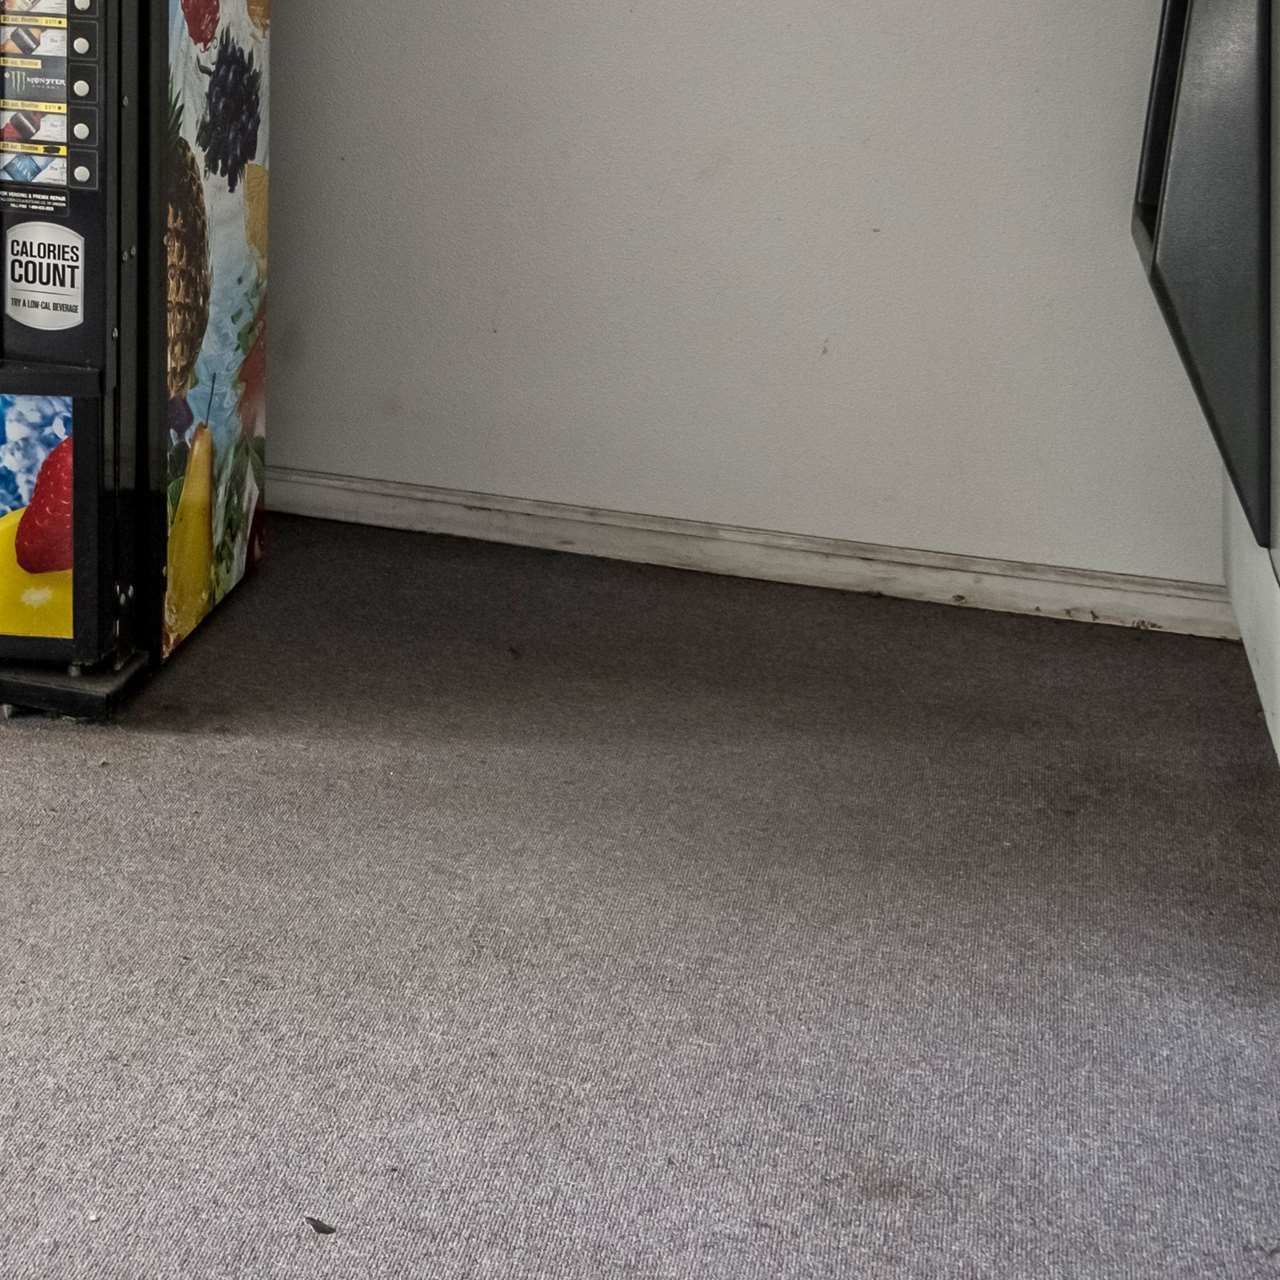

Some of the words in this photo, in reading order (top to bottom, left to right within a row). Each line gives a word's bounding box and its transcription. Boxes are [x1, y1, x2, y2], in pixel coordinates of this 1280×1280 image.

[11, 239, 80, 263] CALORIES
[10, 258, 80, 289] COUNT
[11, 297, 21, 307] TRY
[52, 302, 79, 314] BEVERAGE
